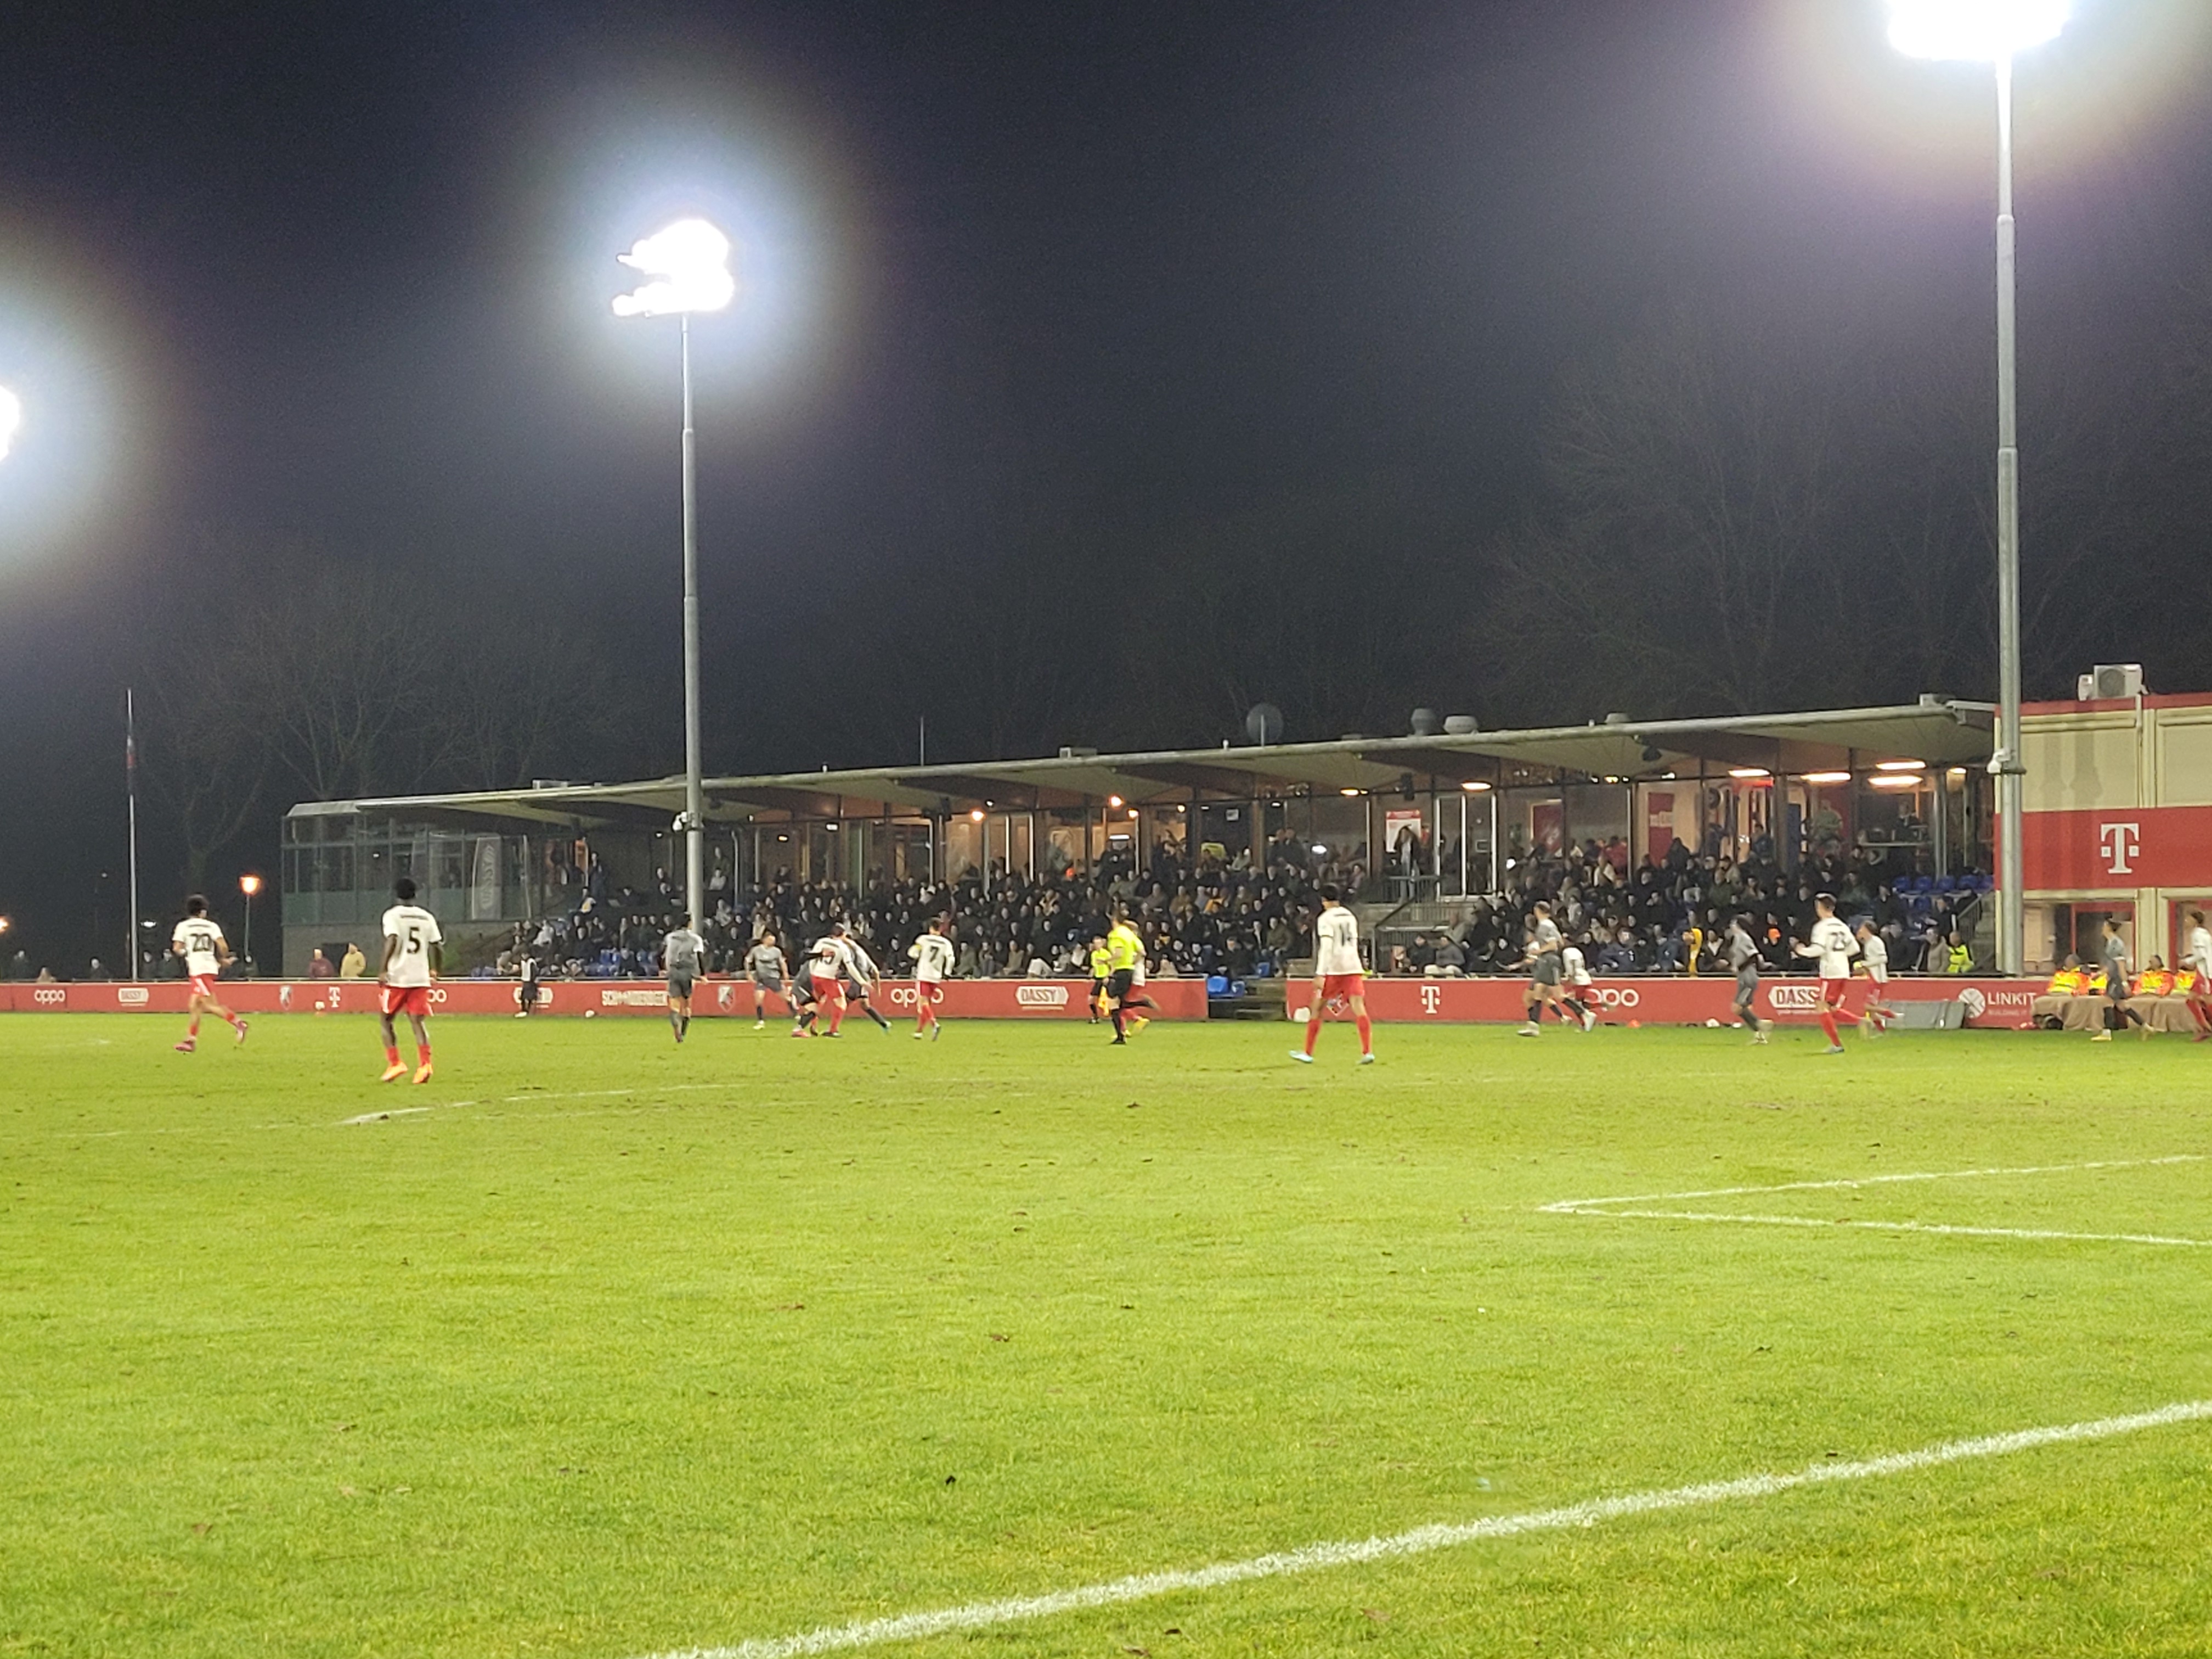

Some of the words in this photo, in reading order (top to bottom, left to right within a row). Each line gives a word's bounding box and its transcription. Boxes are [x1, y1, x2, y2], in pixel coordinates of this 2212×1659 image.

[2100, 823, 2140, 874] T
[407, 927, 421, 954] 5
[929, 946, 940, 962] 7
[34, 989, 65, 1005] oppo
[890, 988, 944, 1008] opo
[1021, 989, 1057, 1002] DASSY
[1420, 985, 1441, 1014] T
[1776, 989, 1819, 1005] DASS
[1987, 992, 2038, 1006] LINKIT
